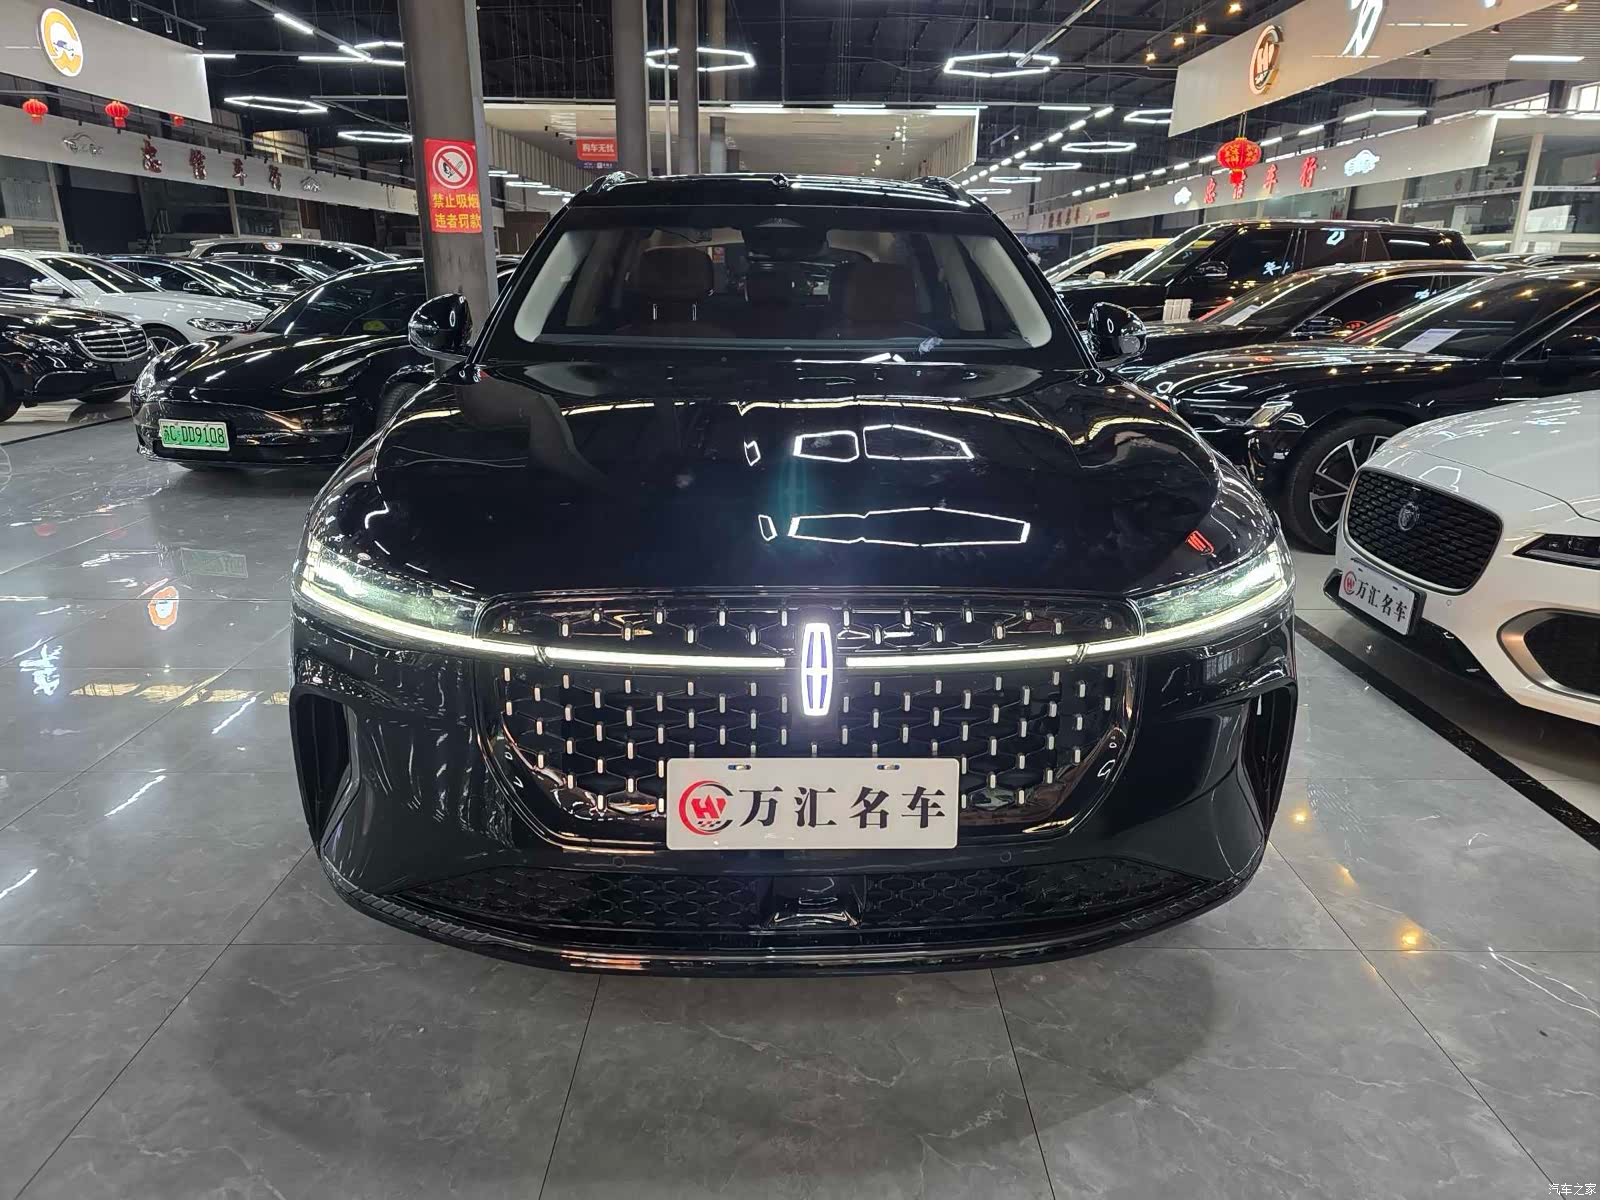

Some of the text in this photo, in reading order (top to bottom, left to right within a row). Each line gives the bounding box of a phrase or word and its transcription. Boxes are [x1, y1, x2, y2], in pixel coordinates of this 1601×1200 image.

[433, 193, 480, 209] 禁止吸烟
[435, 213, 482, 229] 违者罚款
[1356, 579, 1408, 622] 万汇名车
[739, 786, 946, 829] 万汇名车
